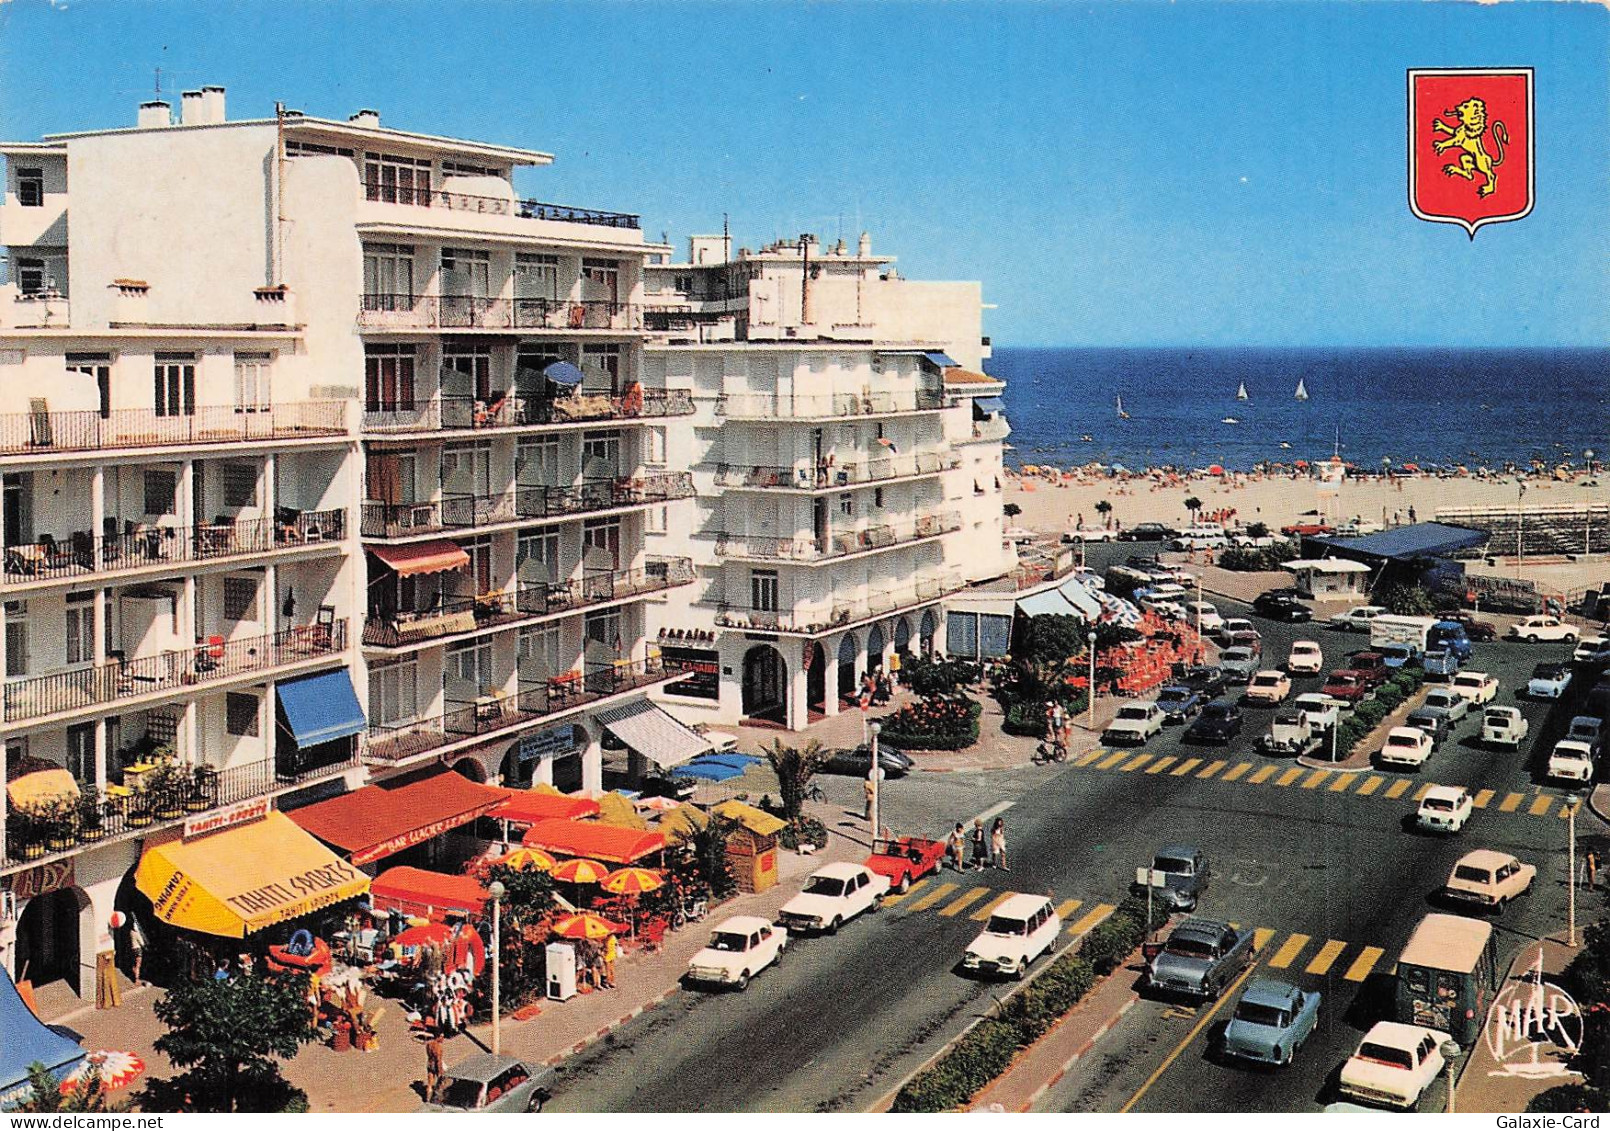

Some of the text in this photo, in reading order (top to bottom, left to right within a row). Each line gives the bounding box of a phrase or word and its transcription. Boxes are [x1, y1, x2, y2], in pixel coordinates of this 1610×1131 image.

[154, 870, 184, 911] CAMPING
[226, 883, 297, 914] TAHITI
[289, 860, 355, 896] SPORTS
[280, 901, 308, 917] TAHITI
